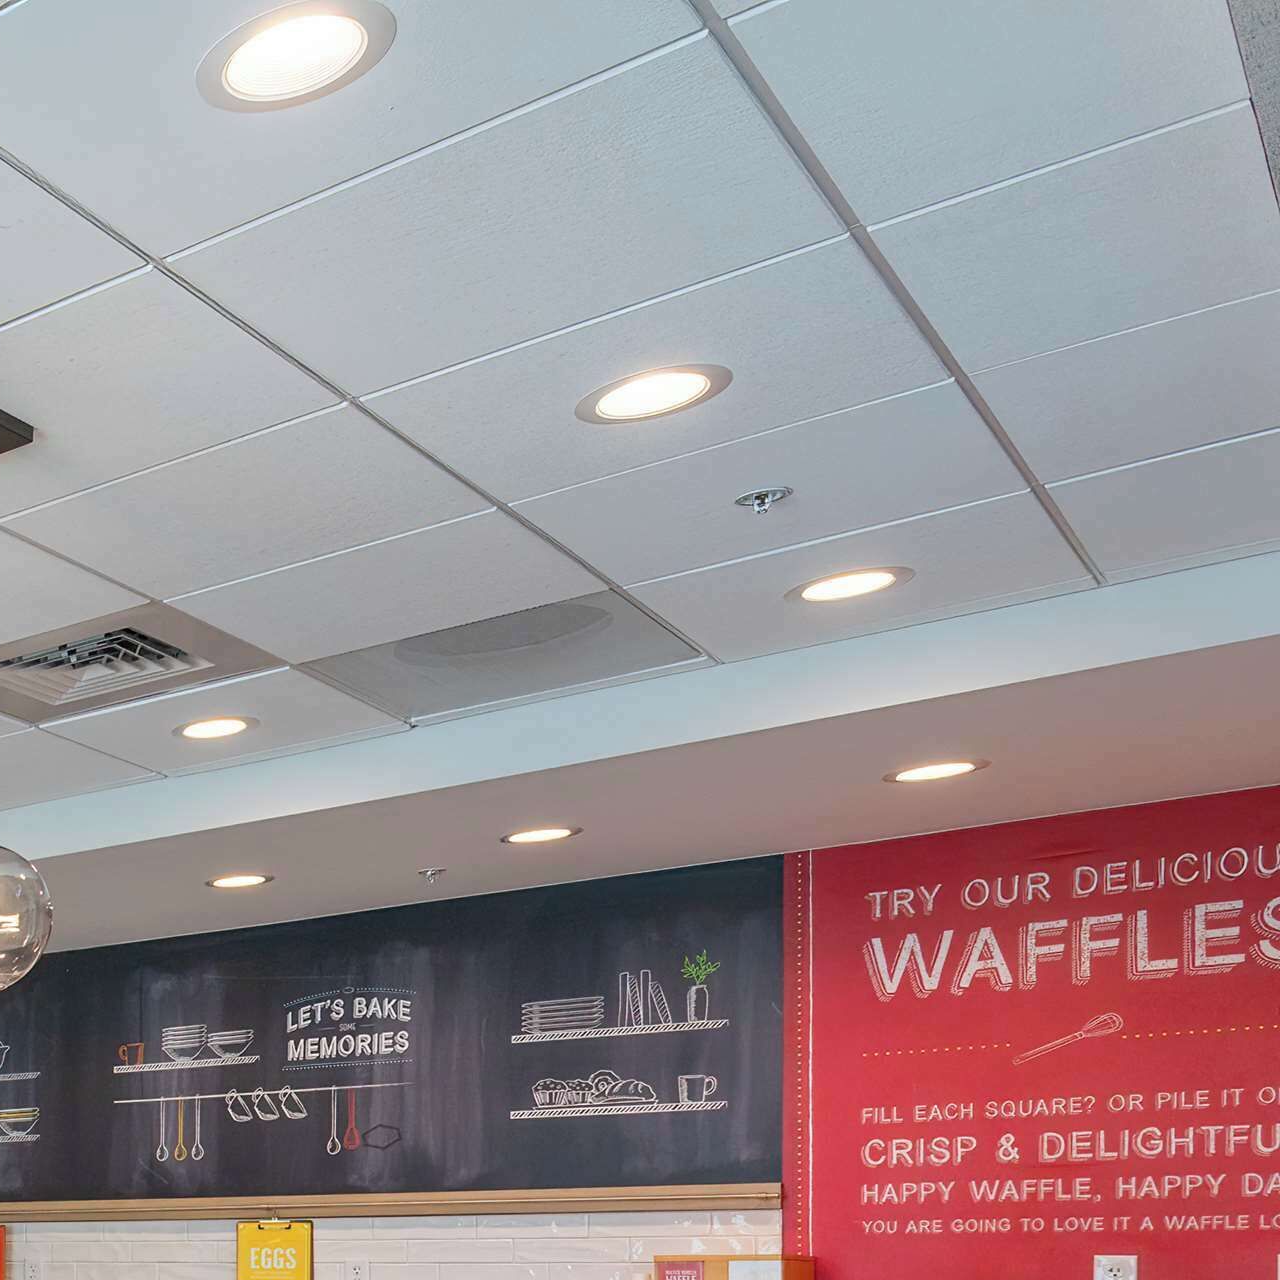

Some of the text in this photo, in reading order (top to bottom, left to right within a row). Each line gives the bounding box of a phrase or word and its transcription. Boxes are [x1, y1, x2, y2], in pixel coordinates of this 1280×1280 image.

[865, 883, 942, 920] TRY
[961, 871, 1052, 909] OUR
[287, 997, 412, 1033] LET'S BAKE
[287, 1030, 409, 1061] MEMORIES
[861, 1106, 904, 1125] FILL
[913, 1102, 974, 1121] EACH
[984, 1095, 1096, 1119] SQUARE?
[1107, 1094, 1144, 1112] OR
[1155, 1089, 1211, 1111] PILE
[1222, 1088, 1244, 1107] IT
[861, 1135, 977, 1168] CRISP
[996, 1133, 1020, 1163] &
[861, 1181, 955, 1205] HAPPY
[969, 1177, 1101, 1204] WAFFLE,
[1116, 1173, 1226, 1200] HAPPY
[862, 1220, 898, 1234] YOU
[905, 1219, 944, 1233] ARE
[951, 1218, 1011, 1233] GOING
[1019, 1217, 1045, 1232] TO
[1053, 1217, 1105, 1232] LOVE
[1112, 1216, 1132, 1232] IT
[1140, 1215, 1154, 1231] A
[1164, 1214, 1249, 1231] WAFFLE
[250, 1247, 297, 1269] EGGS
